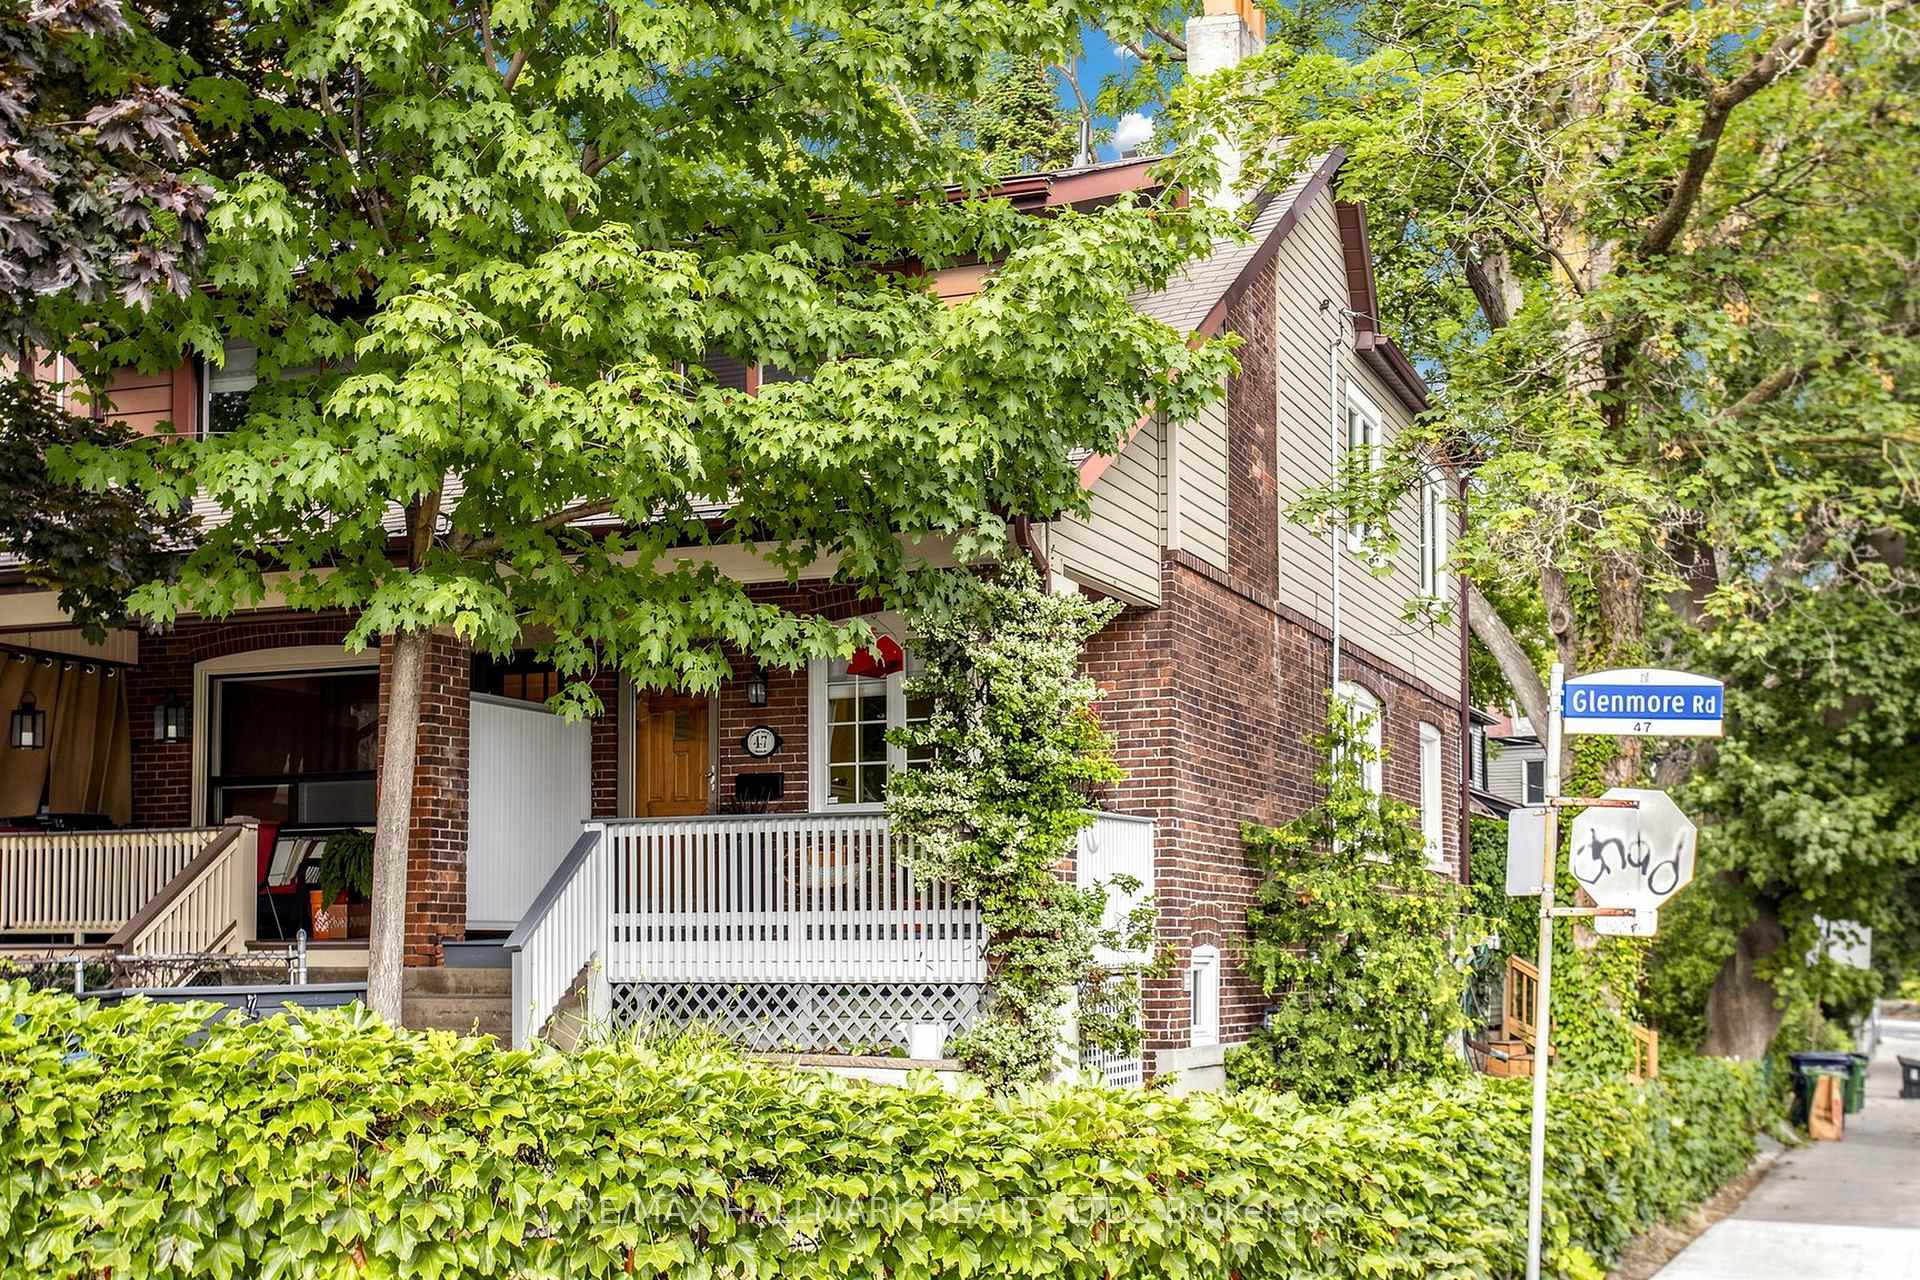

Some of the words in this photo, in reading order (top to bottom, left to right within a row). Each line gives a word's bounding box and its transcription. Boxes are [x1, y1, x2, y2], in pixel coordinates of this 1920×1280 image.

[1572, 689, 1685, 713] Glenmore
[1692, 695, 1716, 714] Rd
[1633, 722, 1652, 733] 47
[752, 735, 768, 748] 47
